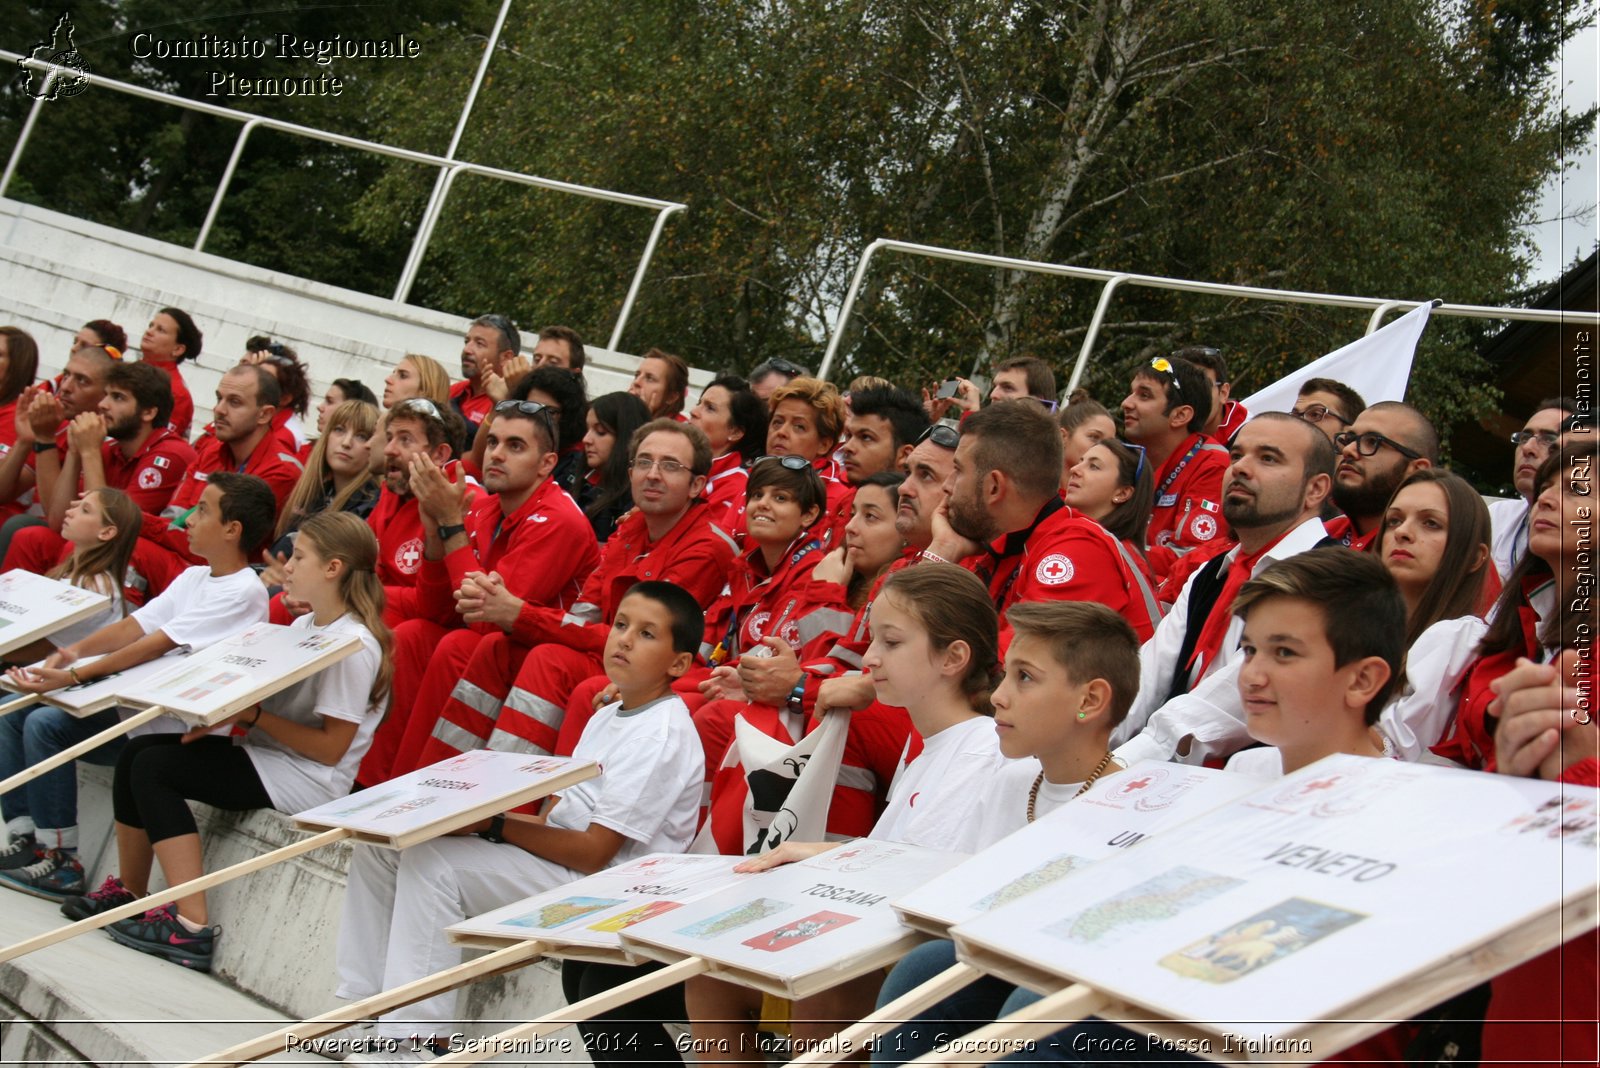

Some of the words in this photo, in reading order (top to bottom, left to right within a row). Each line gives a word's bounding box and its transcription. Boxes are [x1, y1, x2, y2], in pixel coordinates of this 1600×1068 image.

[220, 654, 268, 669] PIEMONTE
[1263, 842, 1397, 883] VENETO
[624, 884, 689, 898] SICILIA
[801, 883, 889, 908] TOSCANA
